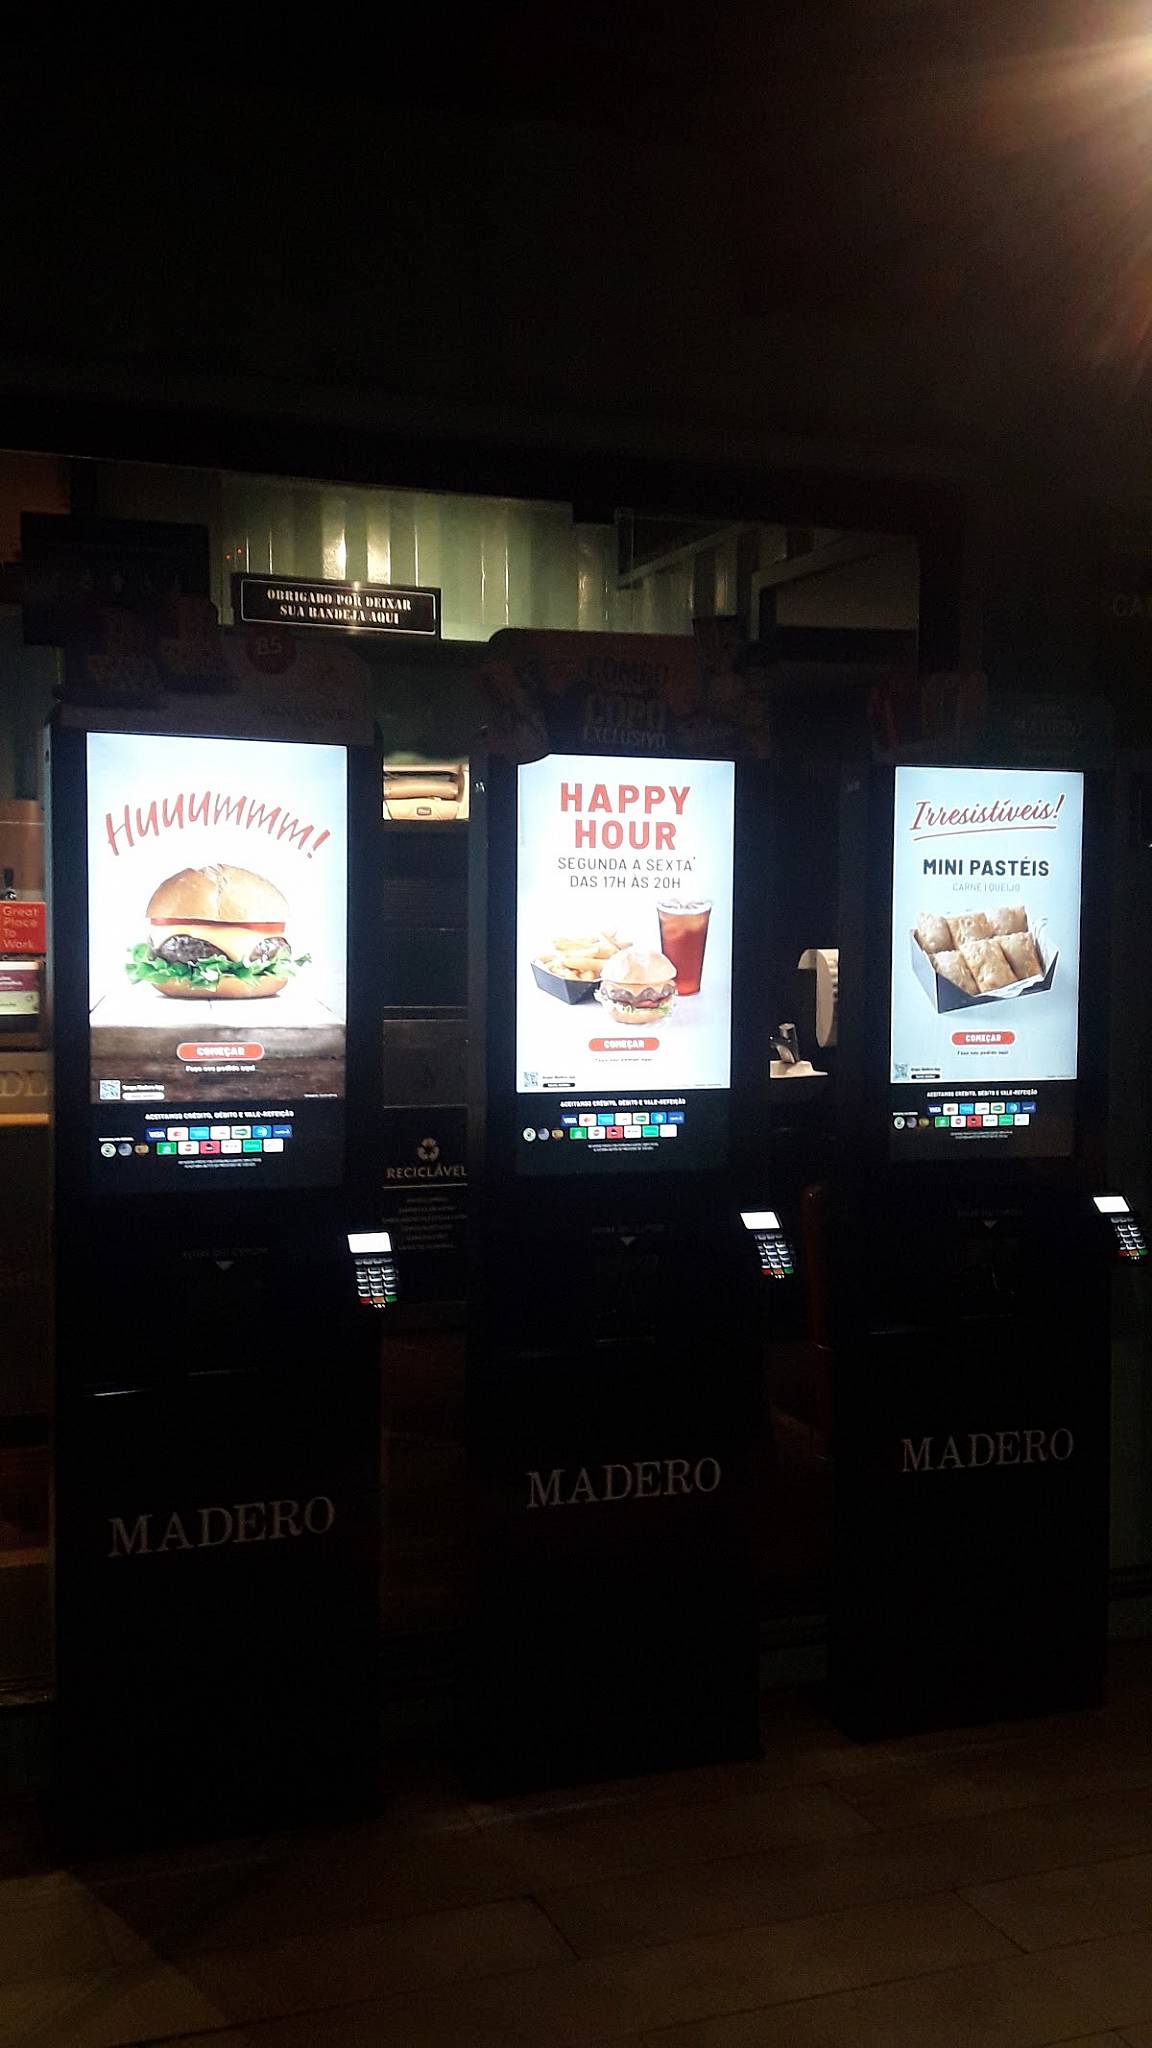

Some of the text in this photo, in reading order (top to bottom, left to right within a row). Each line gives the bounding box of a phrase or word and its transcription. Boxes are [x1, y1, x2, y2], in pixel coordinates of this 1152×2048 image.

[266, 588, 412, 611] OBRIGADO POR DEIXAR
[279, 604, 400, 625] SUA BANDEJA AQUI
[560, 782, 691, 815] HAPPY
[909, 793, 1066, 831] Irresistíveis!
[574, 819, 677, 850] HOUR
[557, 856, 628, 871] SEGUNDA
[632, 858, 642, 871] A
[923, 855, 1050, 877] MINI PASTÉIS
[569, 875, 599, 888] DAS
[603, 876, 627, 889] 17H
[654, 876, 681, 889] 20H
[952, 882, 982, 892] CARNE
[988, 882, 1021, 893] QUEIJO
[3, 906, 38, 917] Great
[3, 917, 38, 928] Place
[3, 928, 17, 938] To
[3, 938, 34, 949] Work
[604, 1039, 645, 1050] COMEÇAR
[965, 1034, 1002, 1043] COMEÇAR
[196, 1046, 246, 1057] COMEÇAR
[385, 1162, 468, 1179] RECICLÁVEL
[899, 1427, 1076, 1473] MADERO
[525, 1456, 722, 1509] MADERO
[106, 1496, 337, 1558] MADERO
